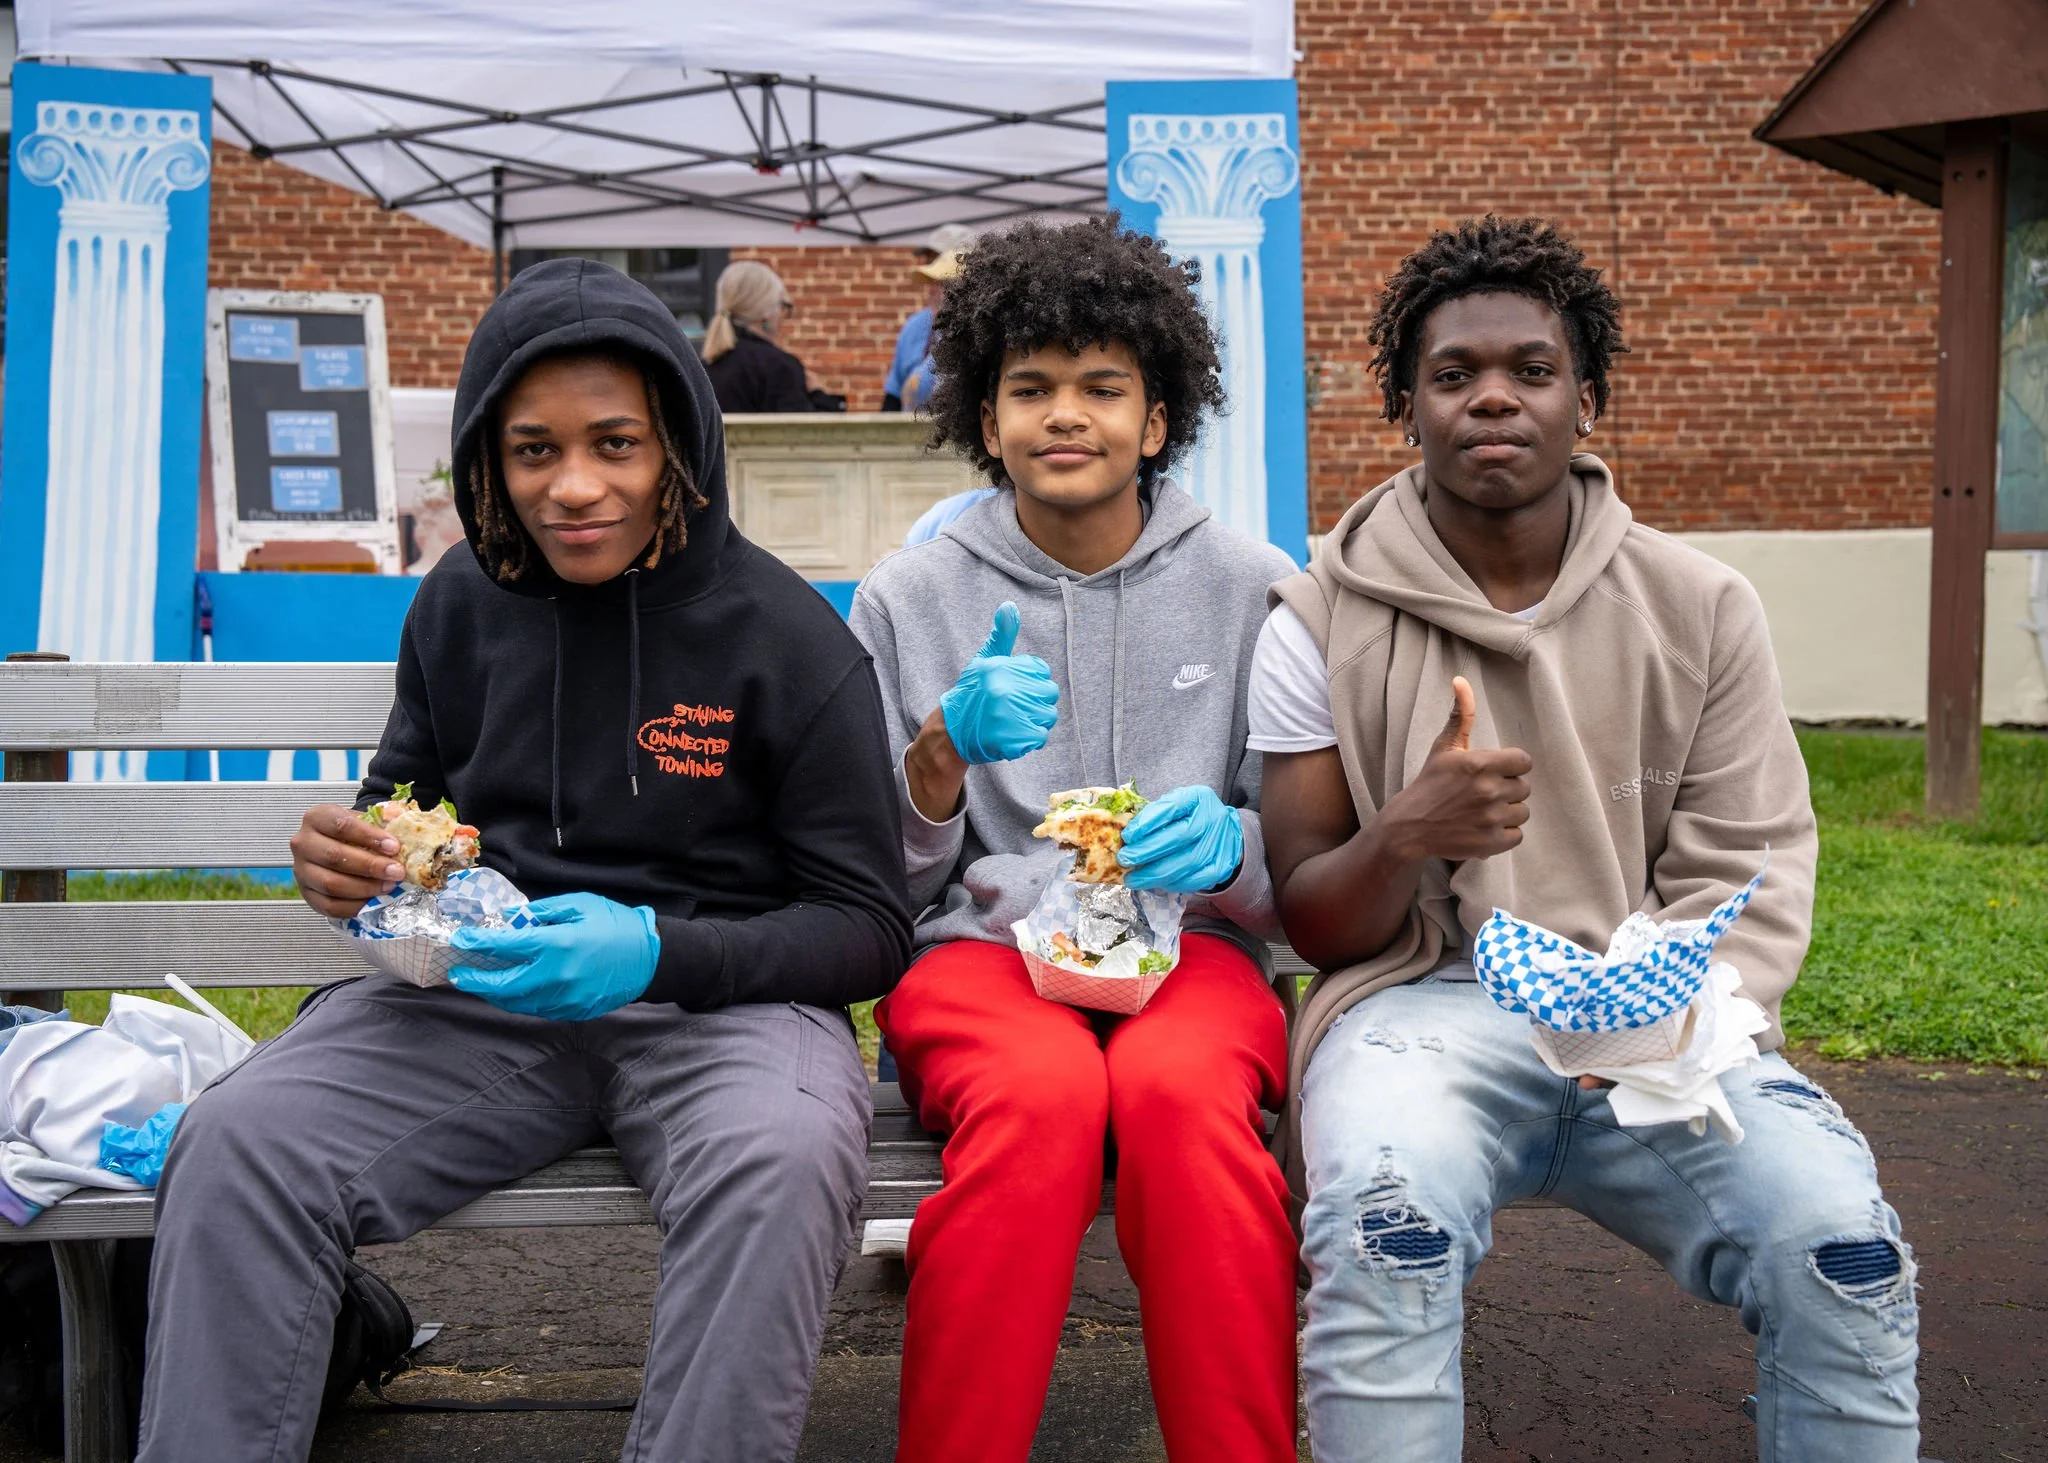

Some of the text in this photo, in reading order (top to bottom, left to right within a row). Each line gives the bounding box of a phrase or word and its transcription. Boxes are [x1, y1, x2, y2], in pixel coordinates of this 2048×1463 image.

[1180, 664, 1210, 679] NIKE
[673, 703, 735, 727] STAYING
[654, 754, 724, 778] TOWING
